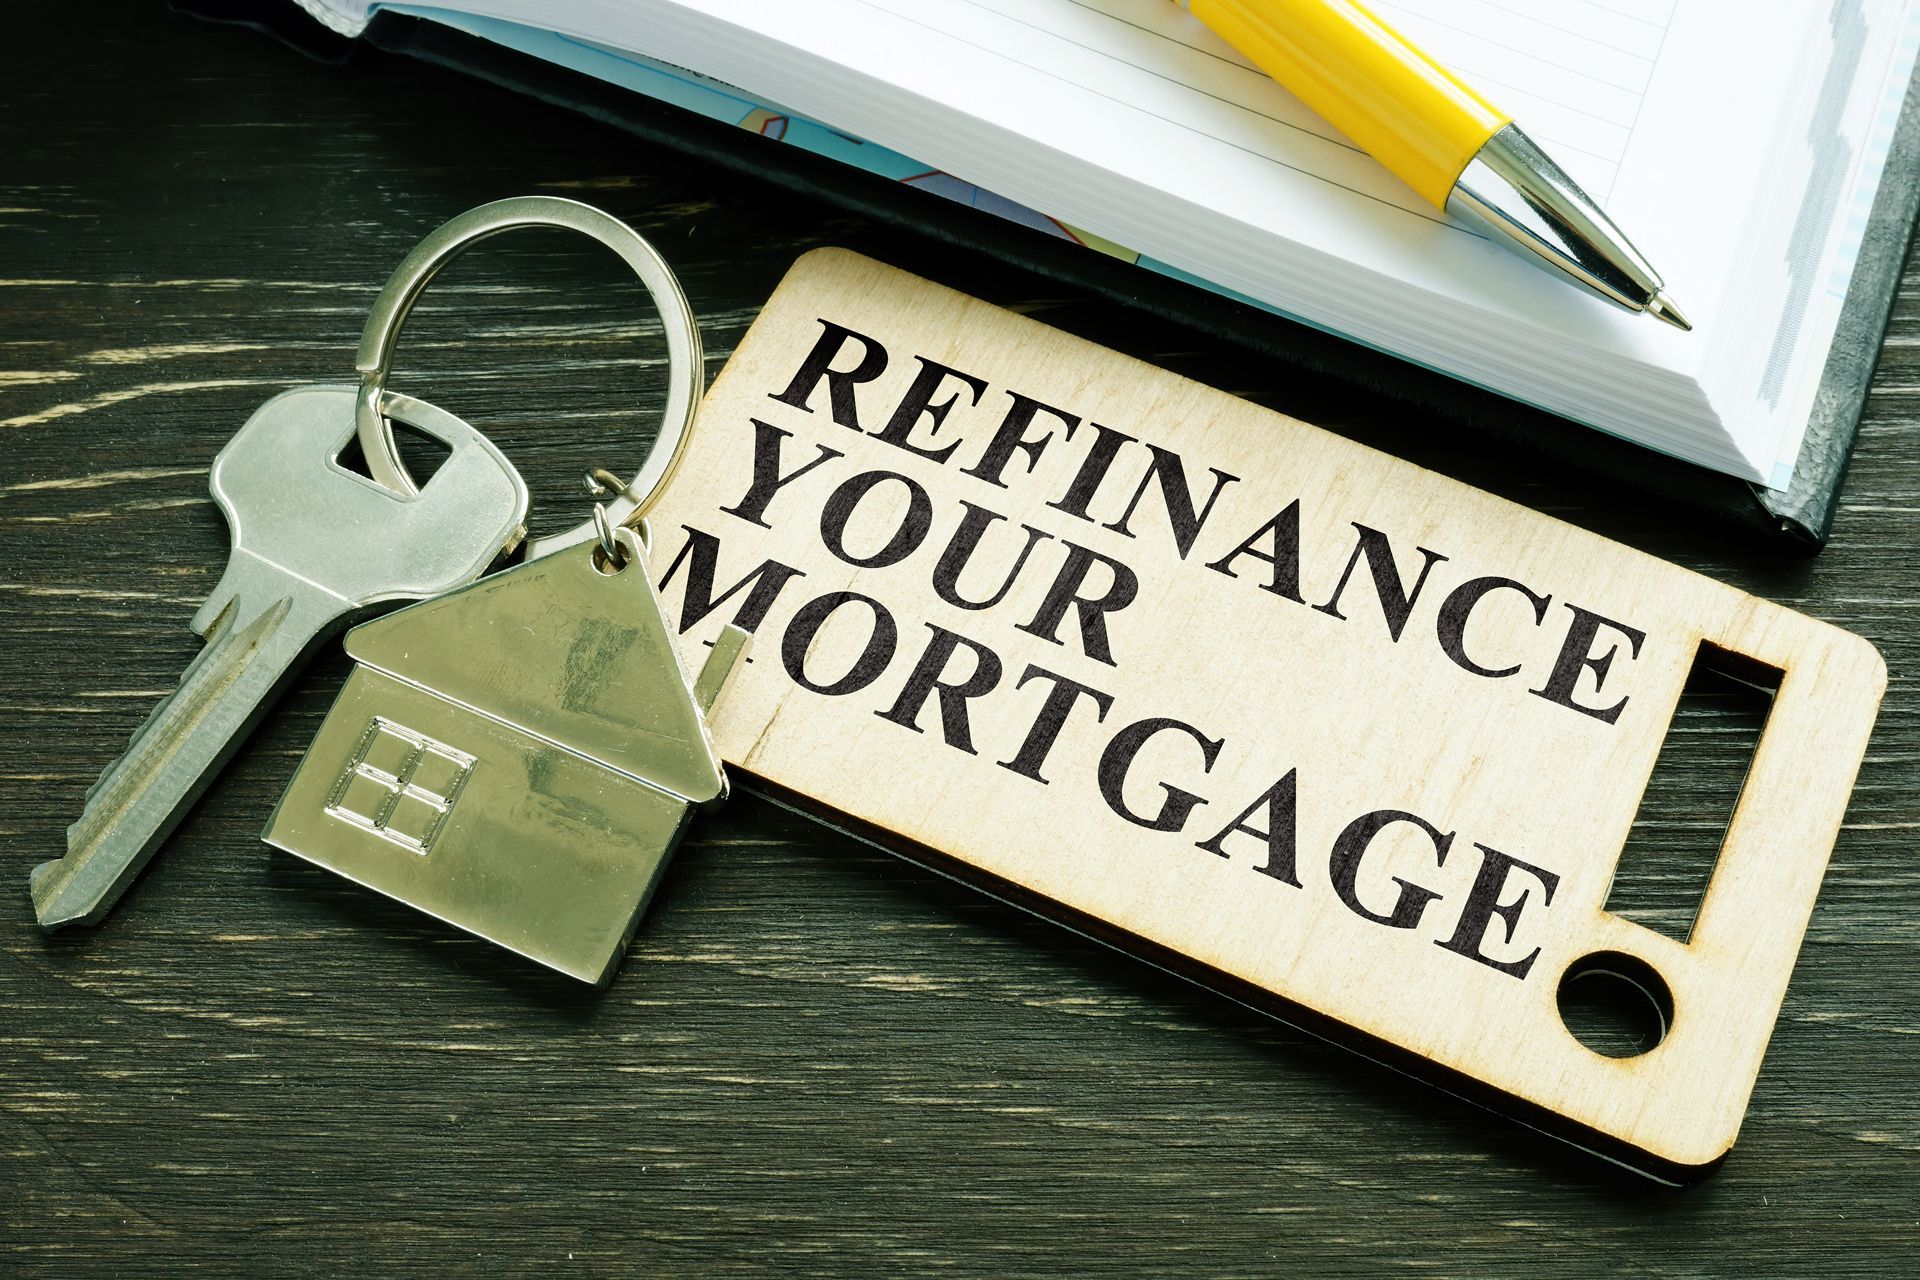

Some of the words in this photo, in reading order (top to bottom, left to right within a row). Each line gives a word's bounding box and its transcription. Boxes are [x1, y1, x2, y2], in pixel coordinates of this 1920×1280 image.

[719, 417, 1138, 668] YOUR
[768, 317, 1647, 726] REFINANCE
[658, 525, 1561, 981] MORTGAGE
